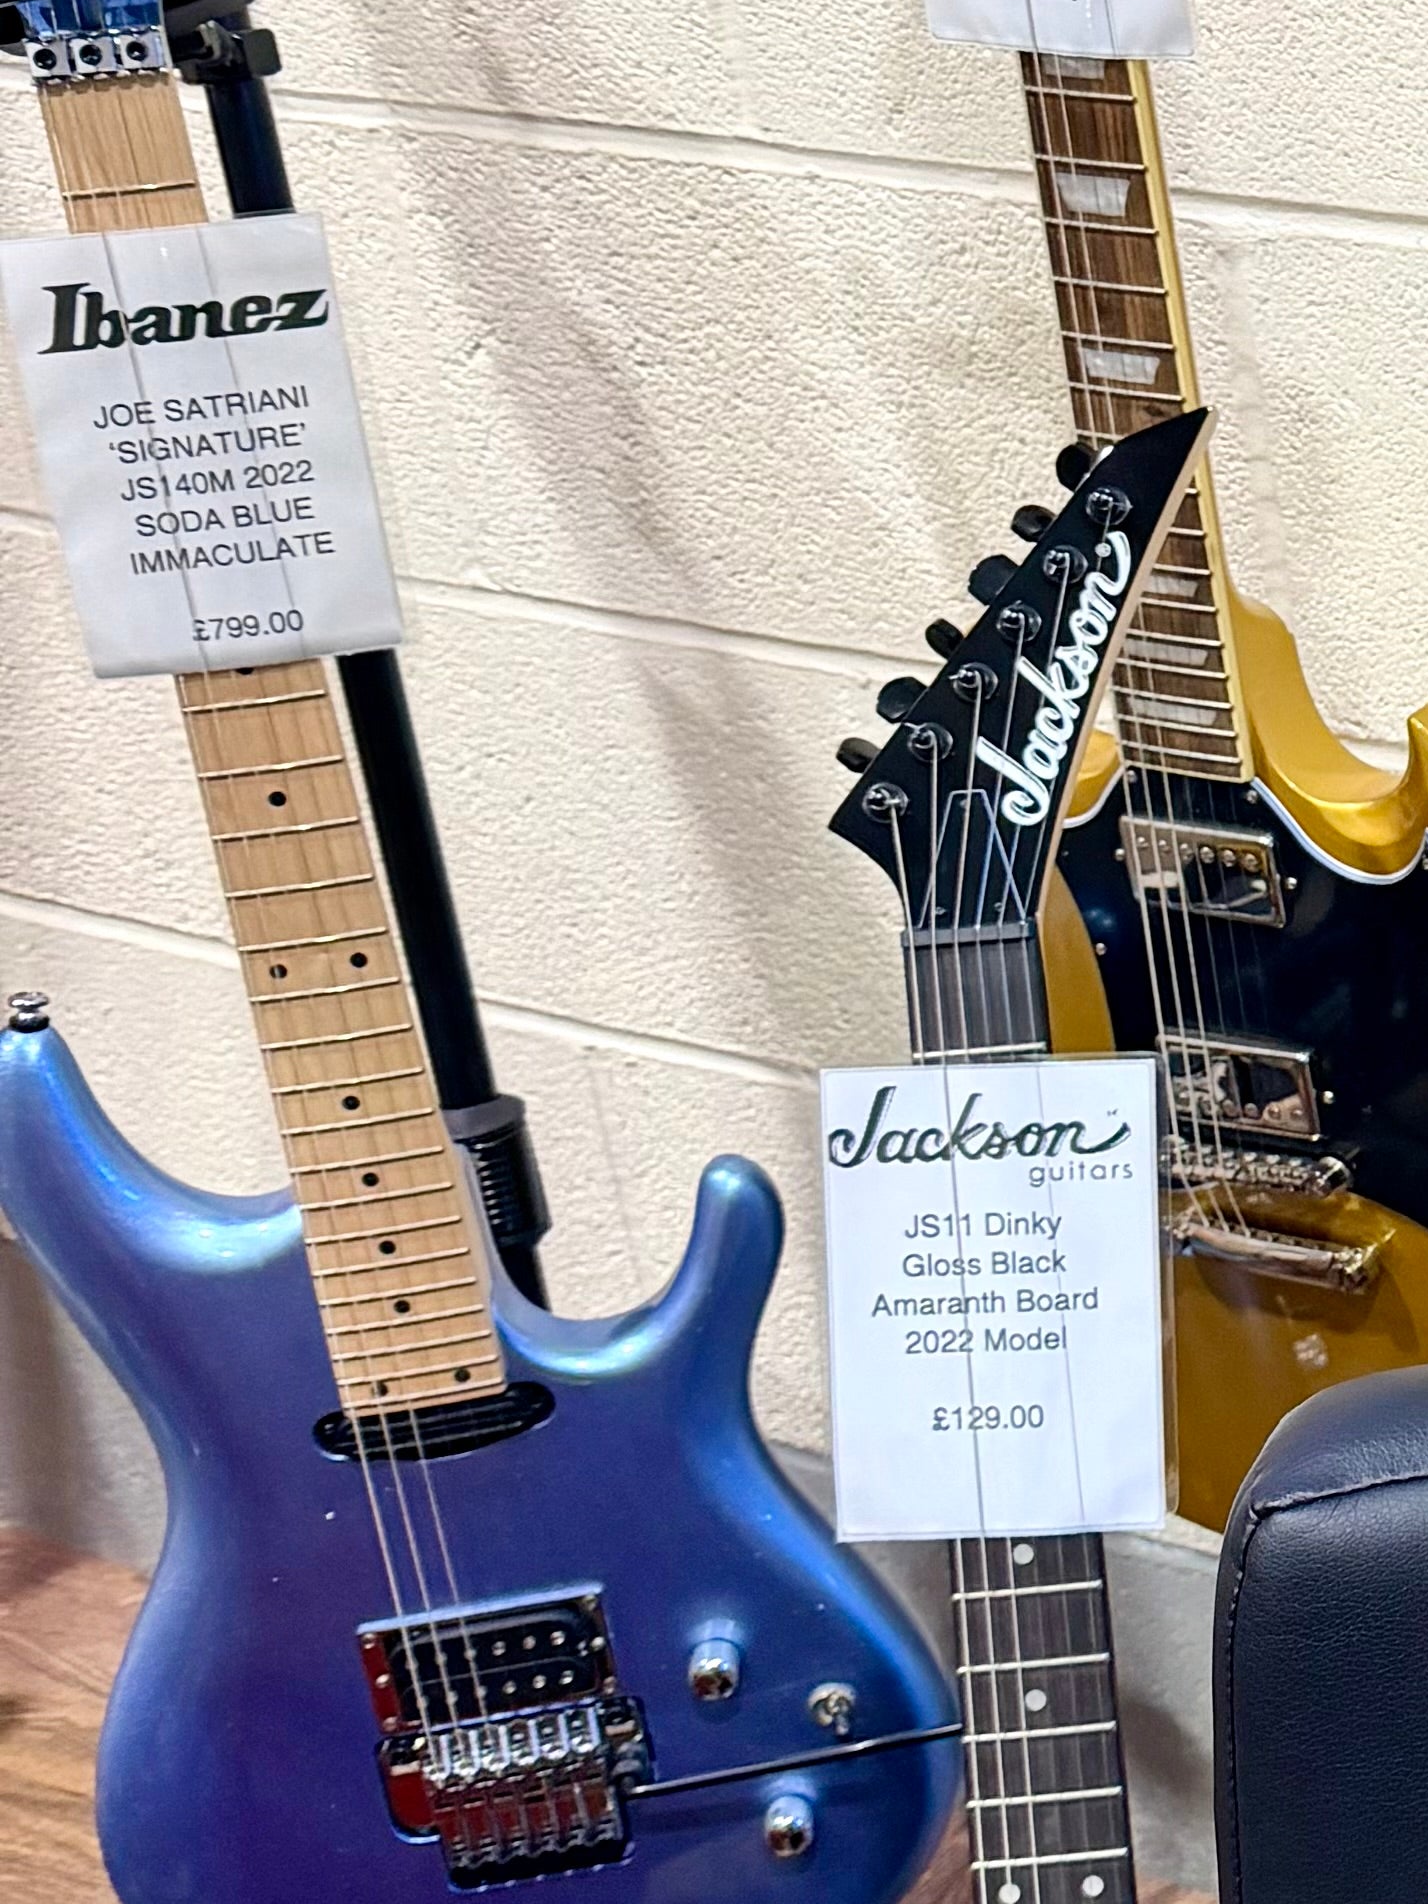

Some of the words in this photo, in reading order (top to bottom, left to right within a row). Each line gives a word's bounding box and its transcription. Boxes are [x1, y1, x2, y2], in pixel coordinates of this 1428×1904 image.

[37, 282, 331, 355] Ibanez
[93, 400, 156, 430] JOE
[164, 385, 310, 423] SATRIANI
[120, 469, 235, 503] JS140M
[243, 459, 316, 490] 2022
[134, 507, 226, 538] SODA
[234, 496, 317, 529] BLUE
[130, 531, 336, 576] IMMACULATE
[192, 609, 304, 643] £799.00
[976, 530, 1132, 827] Jackson
[828, 1085, 1132, 1168] Jackson
[1028, 1160, 1134, 1188] guitars
[904, 1213, 973, 1240] JS11
[985, 1211, 1062, 1240] Dinky
[902, 1253, 982, 1277] Gloss
[991, 1249, 1067, 1276] Black
[871, 1290, 1006, 1318] Amaranth
[1016, 1286, 1099, 1313] Board
[904, 1329, 974, 1355] 2022
[985, 1325, 1068, 1352] Model
[931, 1404, 1045, 1431] £129.00
